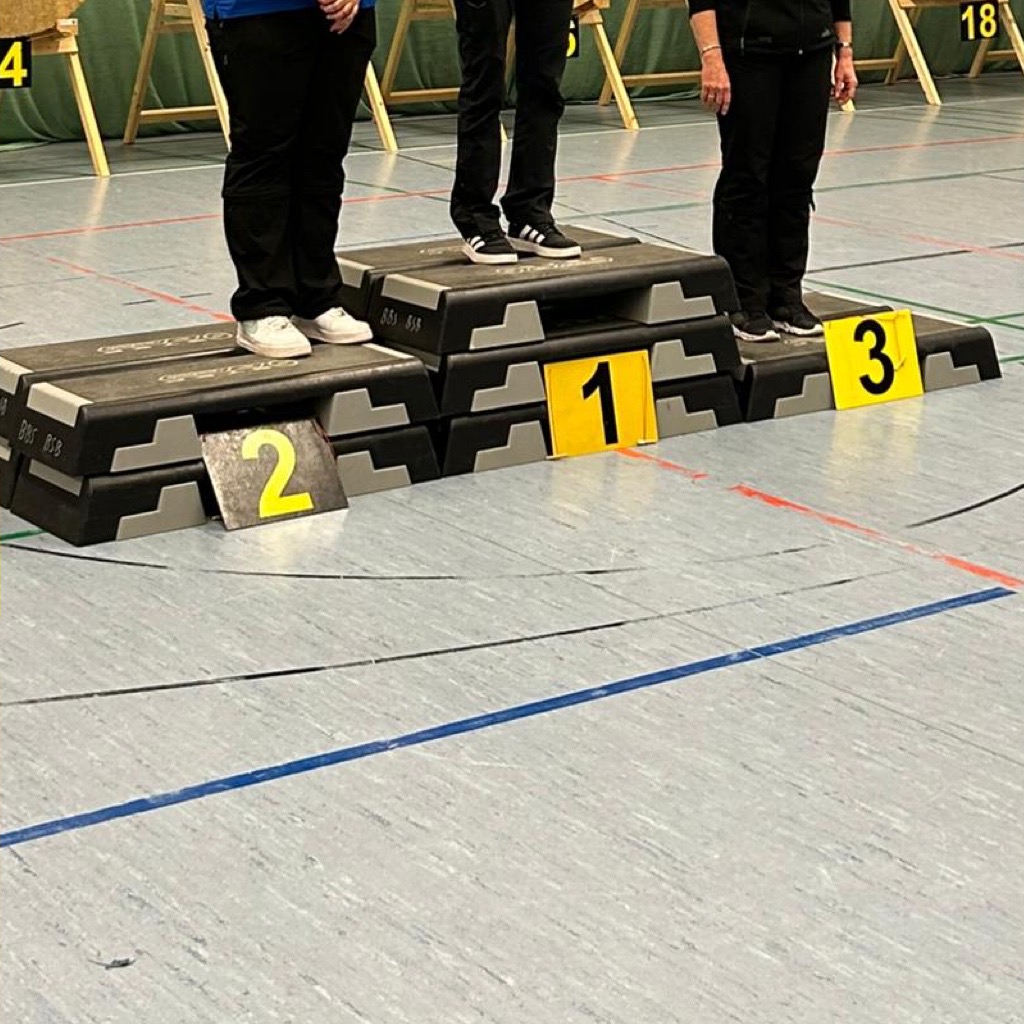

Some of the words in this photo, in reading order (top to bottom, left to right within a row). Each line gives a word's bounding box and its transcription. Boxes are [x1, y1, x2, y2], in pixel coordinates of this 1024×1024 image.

[961, 3, 997, 41] 18
[853, 319, 895, 395] 3
[581, 361, 619, 445] 1
[241, 428, 315, 519] 2
